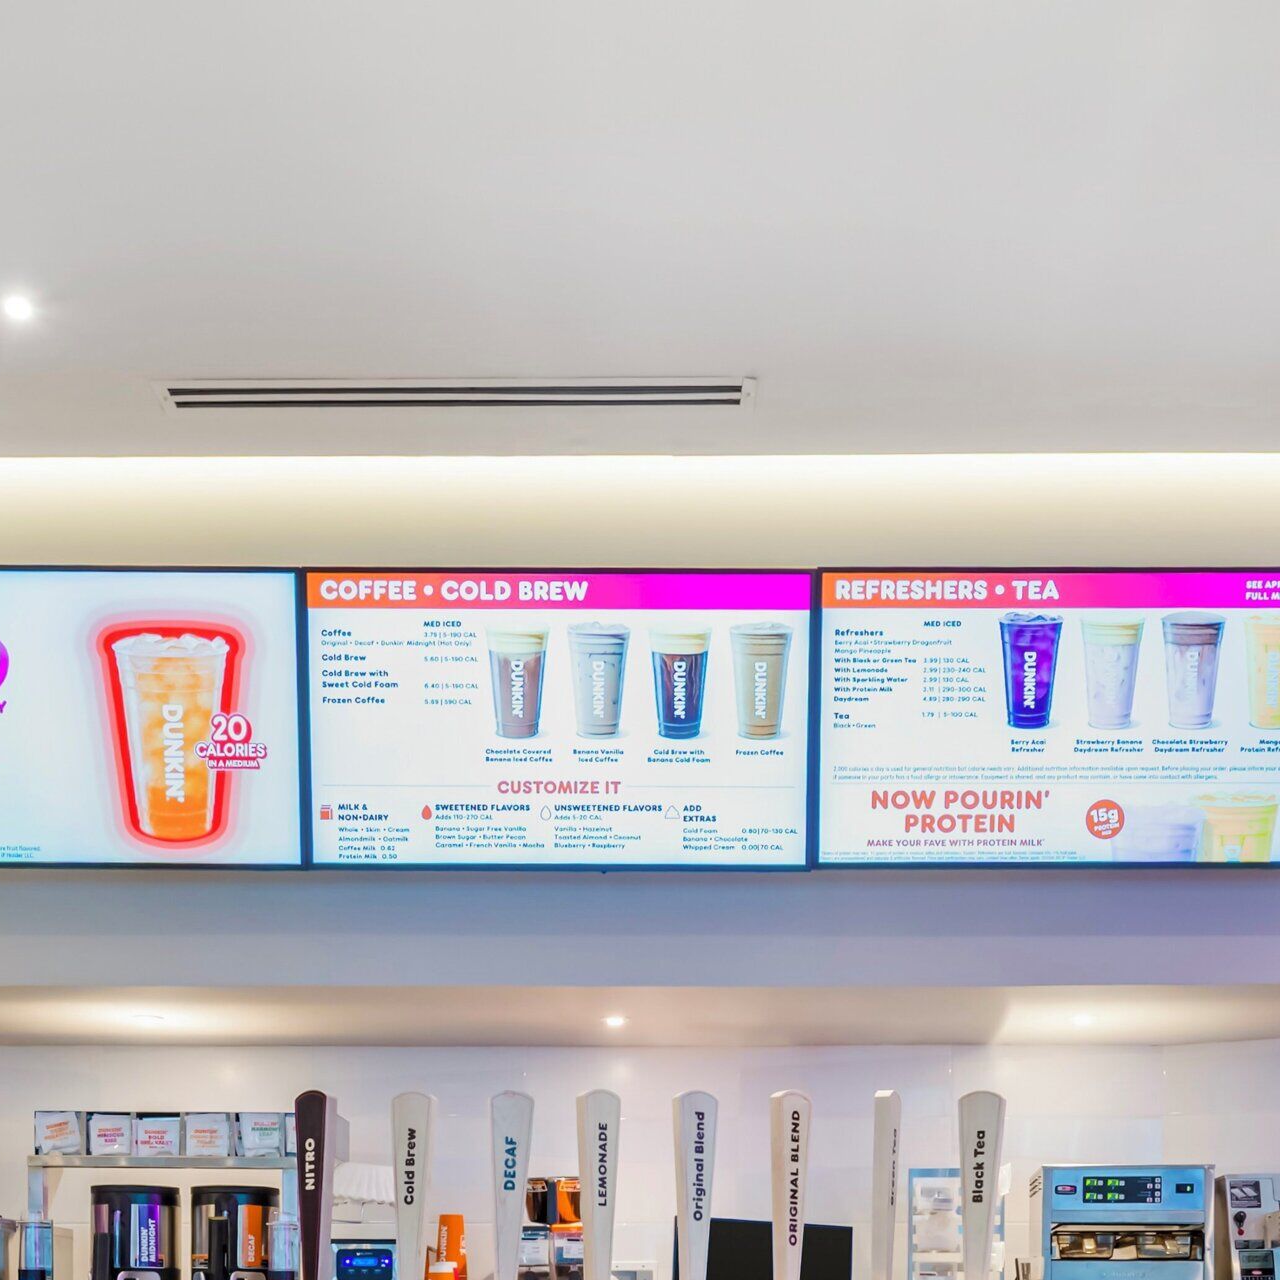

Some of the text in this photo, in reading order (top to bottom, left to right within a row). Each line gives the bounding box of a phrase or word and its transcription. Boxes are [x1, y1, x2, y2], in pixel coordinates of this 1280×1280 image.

[320, 580, 588, 602] COFFEE COLD BREW
[835, 580, 1060, 601] REFRESHERS TEA
[1245, 580, 1263, 589] SEE
[1245, 591, 1269, 601] FULL
[423, 620, 462, 628] MED ICED
[320, 629, 352, 637] Coffee
[834, 628, 884, 637] Refreshers
[321, 653, 367, 662] Cold Brew
[321, 669, 343, 677] Cold
[344, 669, 367, 677] Brew
[1023, 651, 1037, 709] DUNKIN'
[322, 680, 399, 689] Sweet Cold Foam
[322, 696, 386, 704] Frozen Coffee
[833, 712, 850, 720] Tea
[211, 714, 250, 742] 20
[162, 703, 185, 803] DUNKIN'
[195, 742, 267, 758] CALORIES
[225, 760, 259, 768] MEDIUM
[497, 780, 622, 795] CUSTOMIZE IT
[435, 804, 531, 812] SWEETENED FLAVORS
[554, 804, 663, 812] UNSWEETENED FLAVORS
[682, 804, 702, 812] ADD
[872, 791, 1049, 809] NOW POURIN'
[682, 815, 717, 823] EXTRAS
[1090, 807, 1119, 823] 15g
[904, 814, 1015, 833] PROTEIN
[866, 838, 1045, 847] MAKE YOUR FAVE WITH PROTEIN MILK
[305, 1137, 316, 1191] NITRO
[403, 1127, 417, 1206] Cold Brew
[503, 1135, 519, 1191] DECAF
[598, 1121, 608, 1207] LEMONADE
[693, 1111, 705, 1222] Original Blend
[971, 1129, 986, 1203] Black Tea
[788, 1110, 801, 1247] ORIGINAL BLEND
[148, 1218, 156, 1263] MIDNIGHT
[248, 1234, 256, 1262] DECAF
